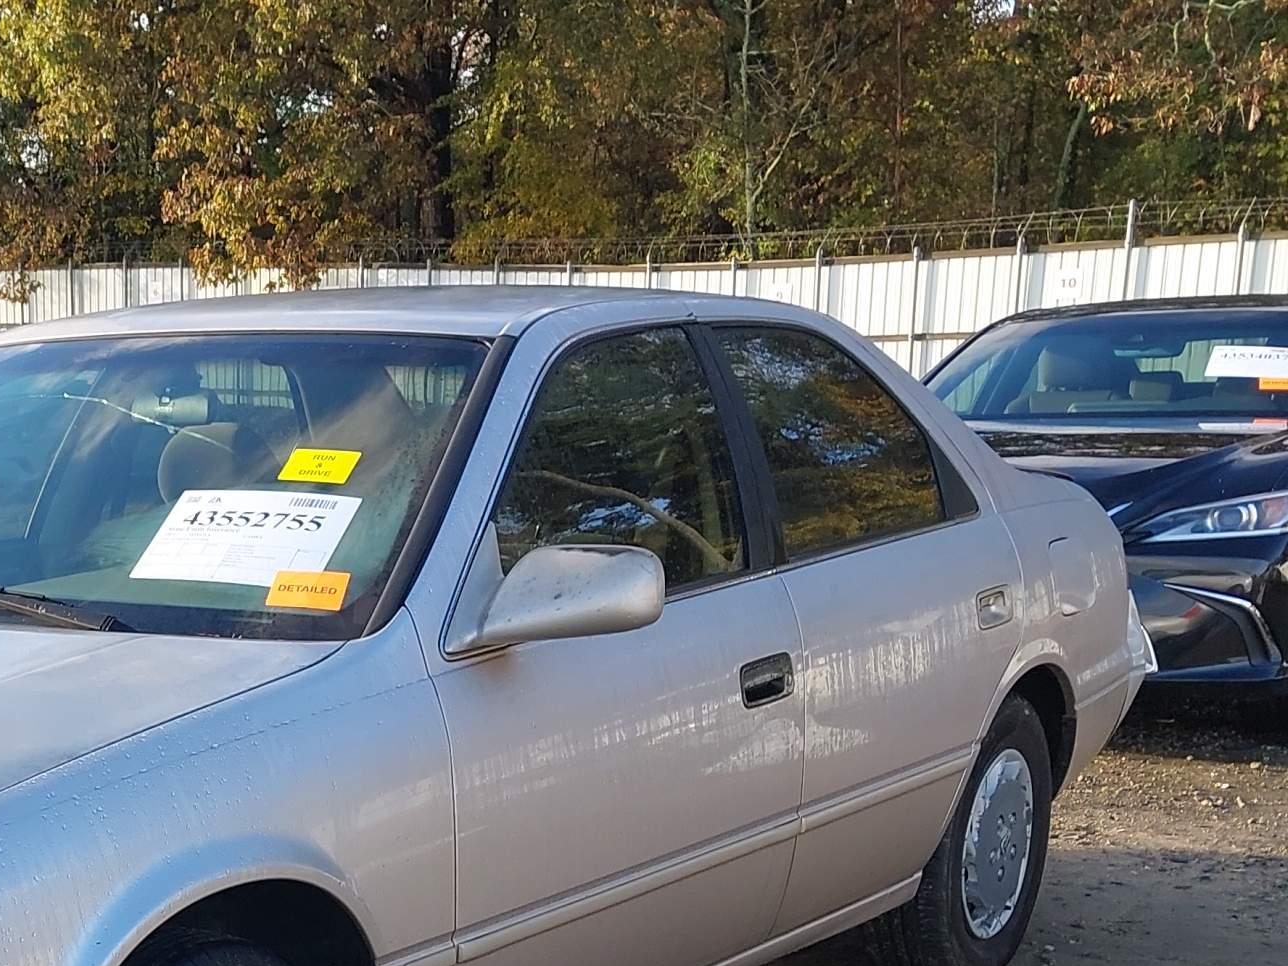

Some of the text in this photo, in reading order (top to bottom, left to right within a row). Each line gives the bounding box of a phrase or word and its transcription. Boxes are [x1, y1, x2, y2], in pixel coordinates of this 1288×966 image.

[1060, 276, 1077, 289] 10
[298, 469, 332, 477] DRIVE
[183, 510, 326, 531] 43552755
[277, 583, 338, 596] DETAILED
